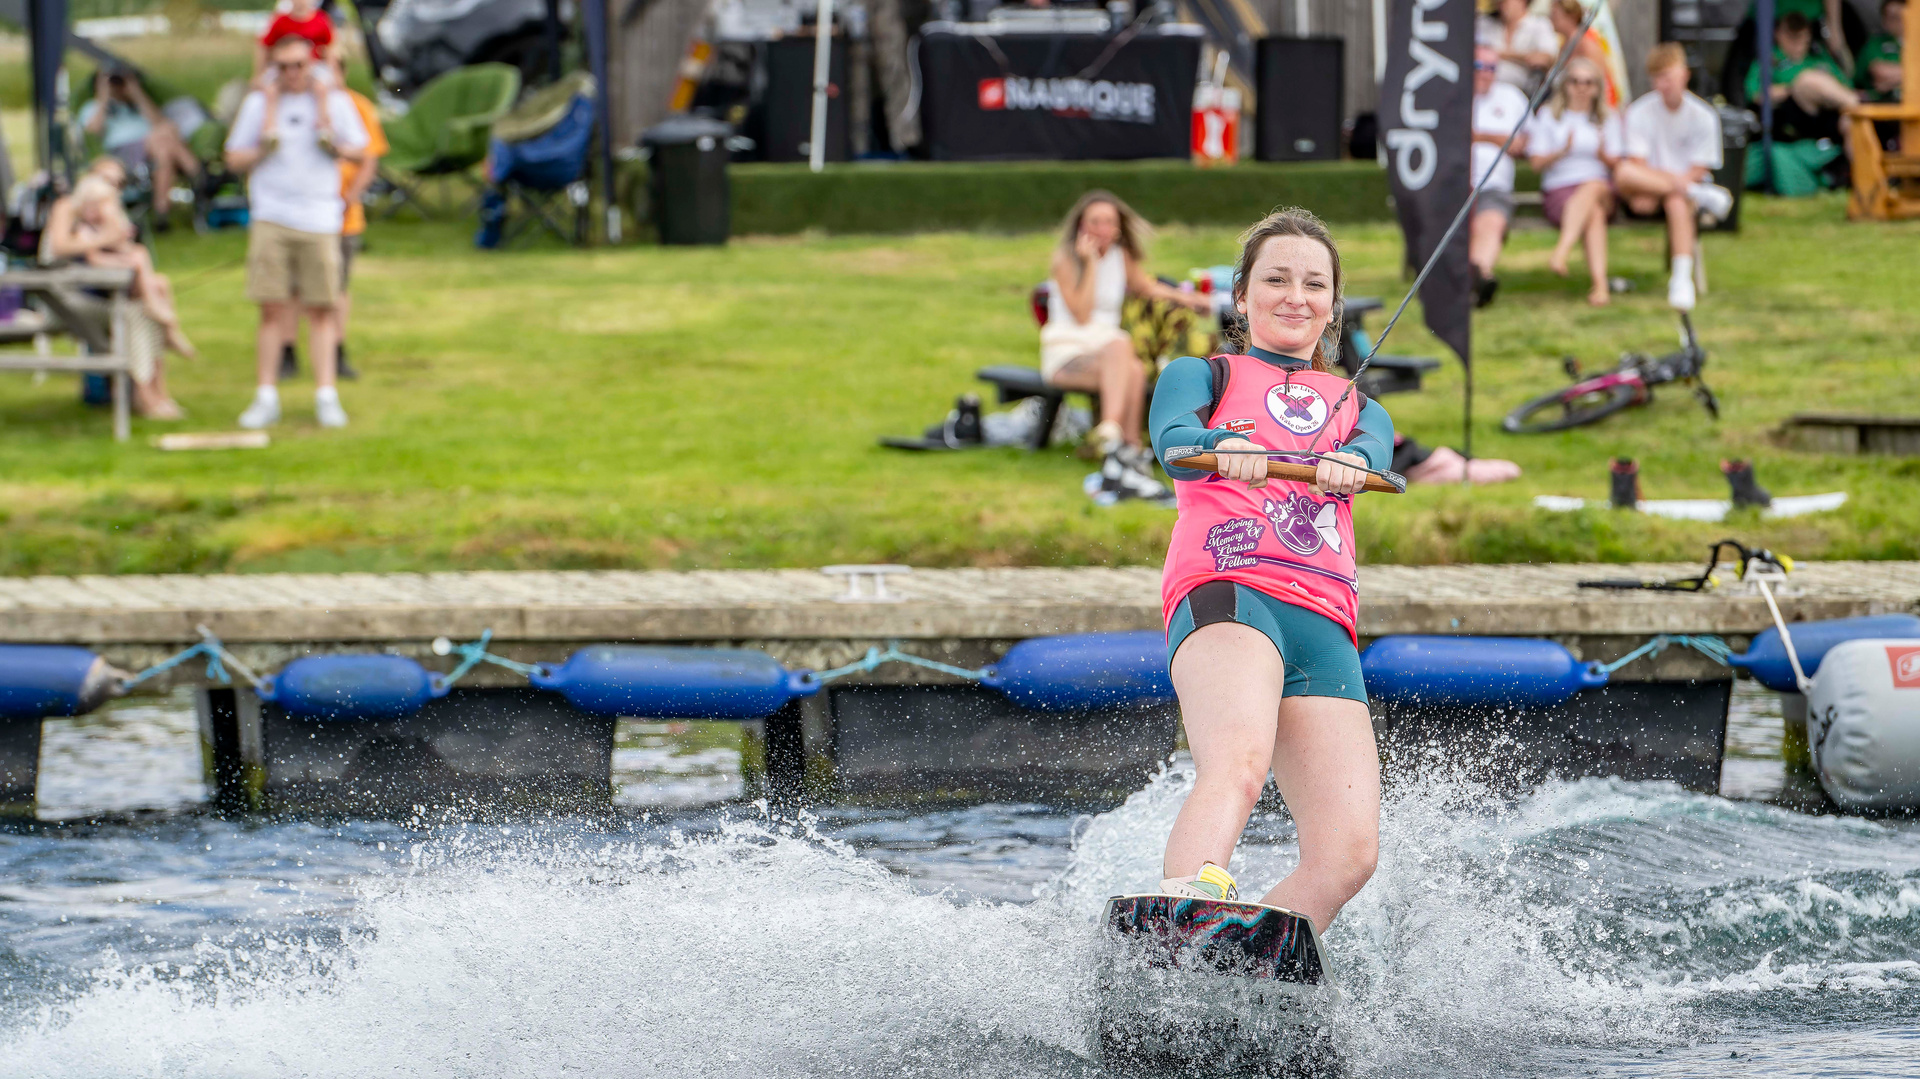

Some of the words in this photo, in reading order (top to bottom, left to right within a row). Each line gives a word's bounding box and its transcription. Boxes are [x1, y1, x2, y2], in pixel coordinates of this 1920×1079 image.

[1005, 76, 1156, 118] NAUTIQUE
[1386, 0, 1460, 190] dryr
[1280, 415, 1294, 427] Wake
[1205, 532, 1245, 549] Memory
[1245, 526, 1263, 539] Of
[1209, 525, 1223, 538] In
[1222, 519, 1254, 533] Loving
[1216, 542, 1256, 557] Larissa
[1217, 555, 1258, 571] Fellows
